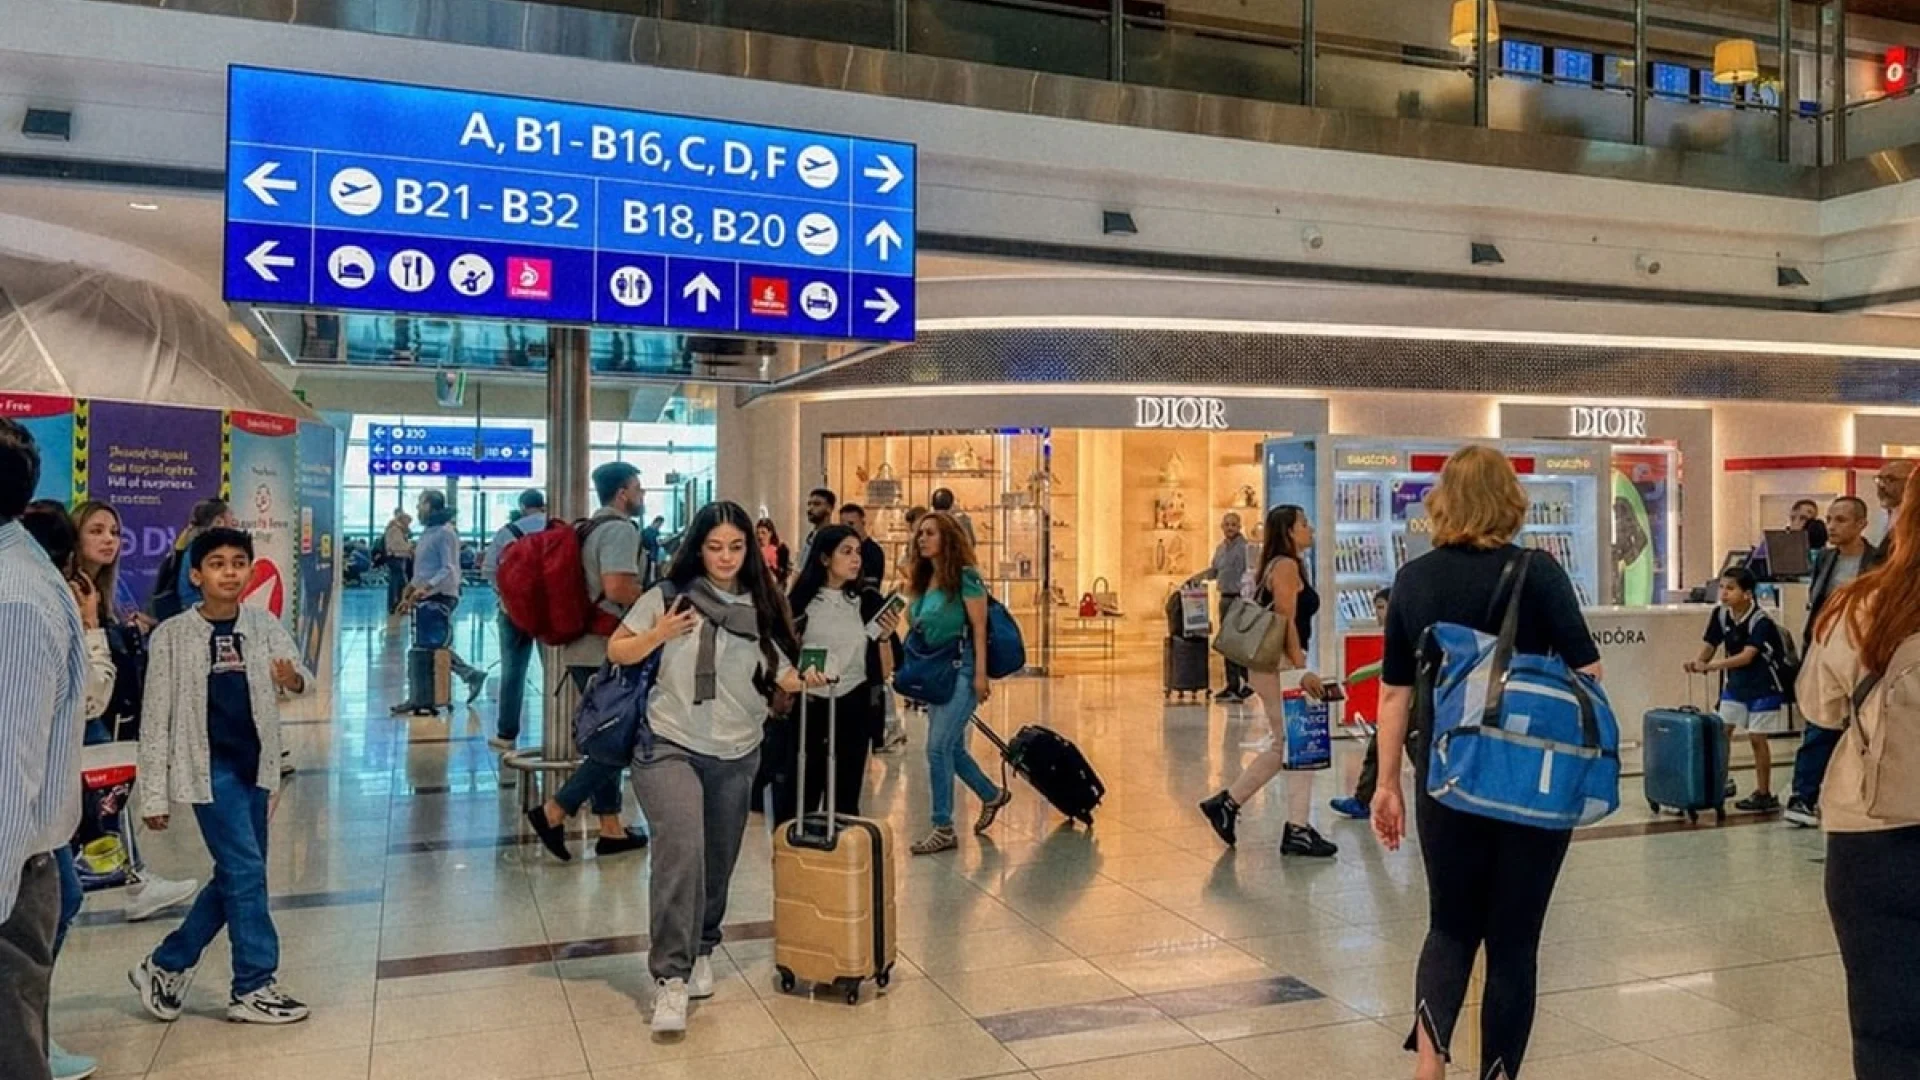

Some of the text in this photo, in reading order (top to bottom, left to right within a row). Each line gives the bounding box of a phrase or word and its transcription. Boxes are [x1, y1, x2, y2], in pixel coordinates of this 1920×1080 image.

[460, 112, 505, 154] A,
[679, 137, 715, 176] C,
[724, 140, 758, 181] D,
[767, 145, 787, 178] F
[623, 200, 786, 247] B18, B20
[1135, 397, 1229, 429] DIOR
[1570, 407, 1647, 438] DIOR
